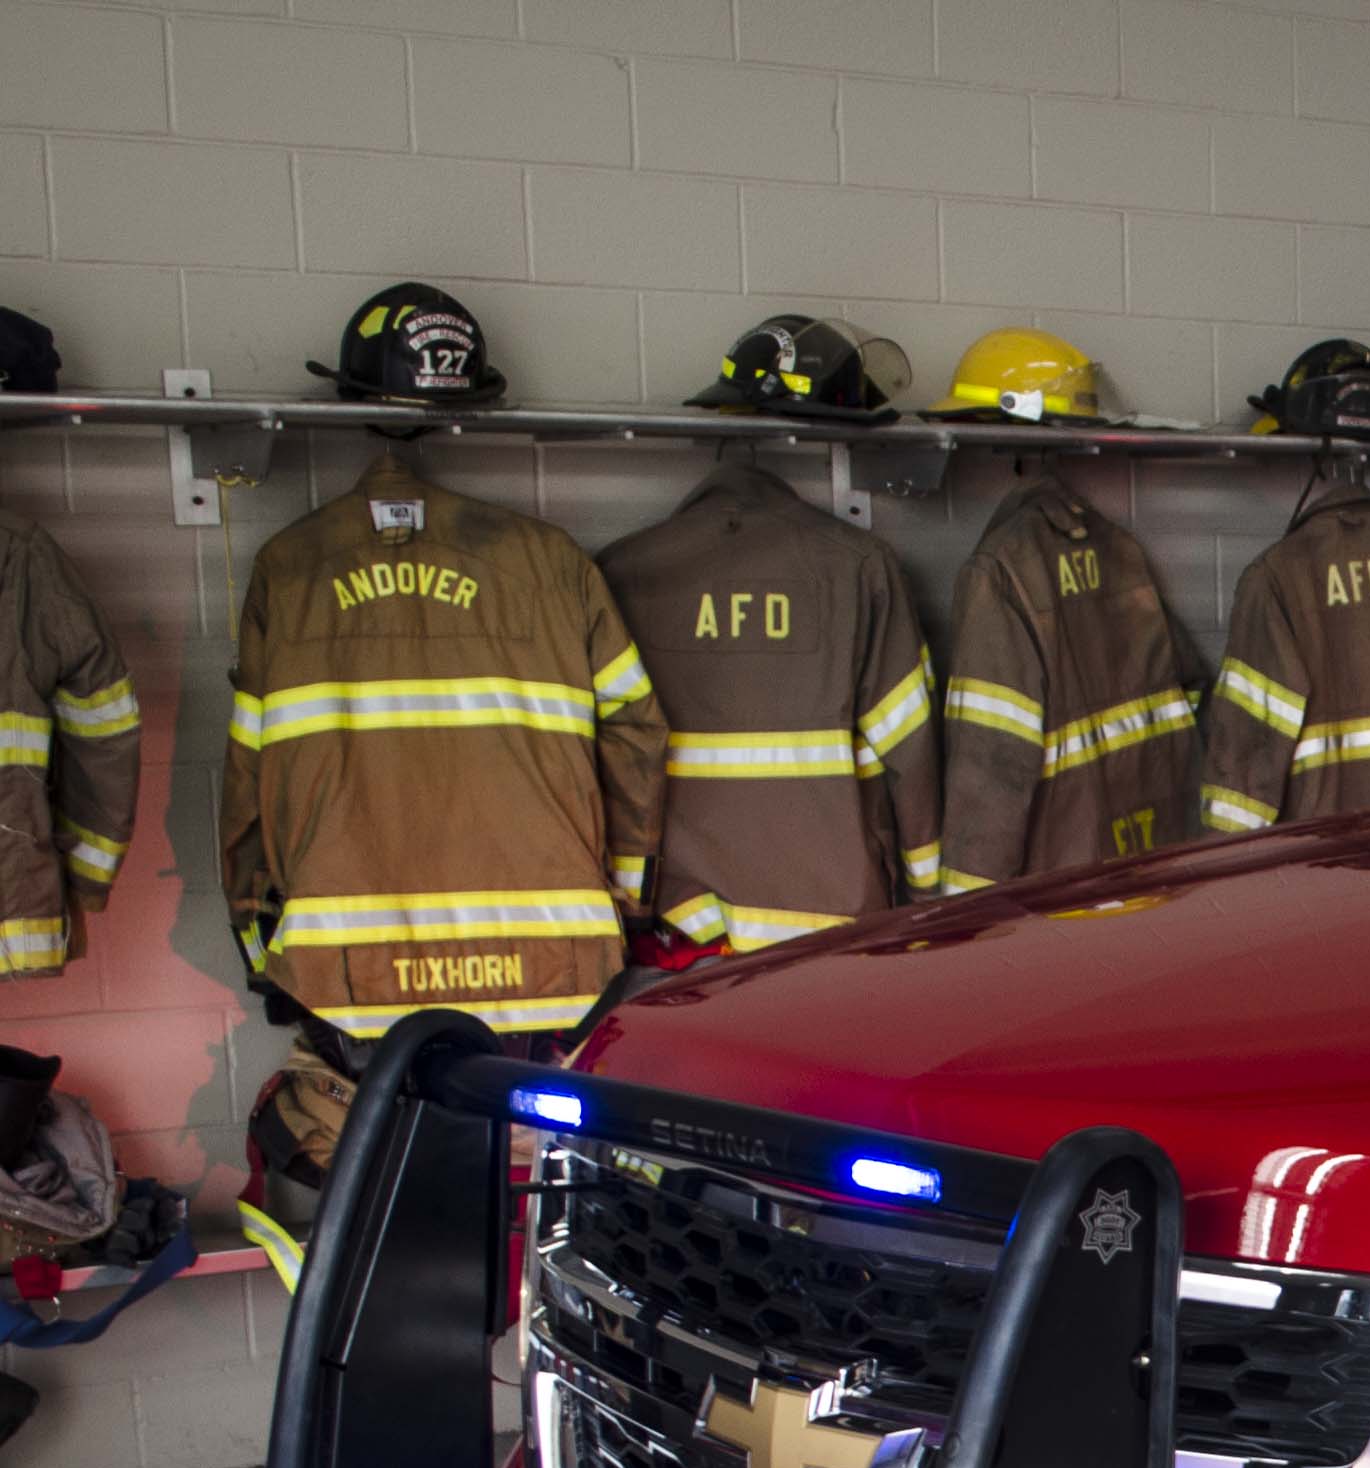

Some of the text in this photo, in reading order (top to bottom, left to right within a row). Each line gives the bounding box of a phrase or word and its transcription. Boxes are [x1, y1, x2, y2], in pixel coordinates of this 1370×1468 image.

[419, 349, 468, 375] 127
[333, 561, 479, 611] ANDOVER
[1058, 549, 1100, 597] AFD
[695, 592, 790, 639] AFD
[393, 953, 523, 993] TUXHORN
